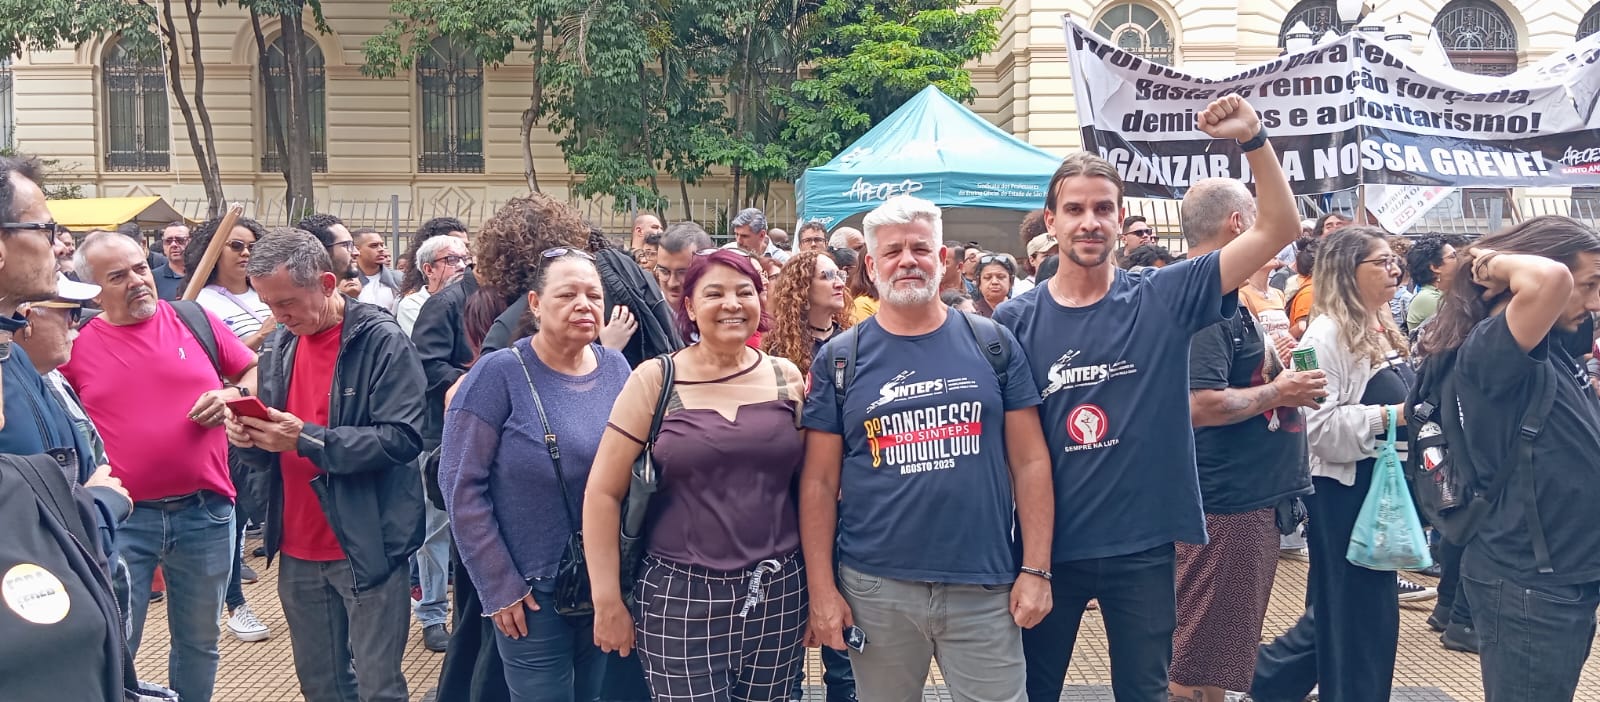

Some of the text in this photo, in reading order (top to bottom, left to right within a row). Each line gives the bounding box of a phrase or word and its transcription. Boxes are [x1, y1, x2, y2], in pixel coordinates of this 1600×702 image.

[1283, 43, 1348, 72] para
[1135, 78, 1217, 101] Basta
[1259, 66, 1390, 98] remoção
[1396, 76, 1536, 106] forçada,
[1289, 107, 1309, 127] e
[1317, 96, 1542, 134] autoritarismo!
[1281, 149, 1306, 182] A
[1313, 139, 1429, 180] NOSSA
[1430, 147, 1551, 177] GREVE!
[895, 424, 970, 444] DO SINTEPS
[1064, 443, 1093, 453] SEMPRE
[1103, 438, 1120, 448] LUTA
[900, 458, 955, 475] AGOSTO 2025
